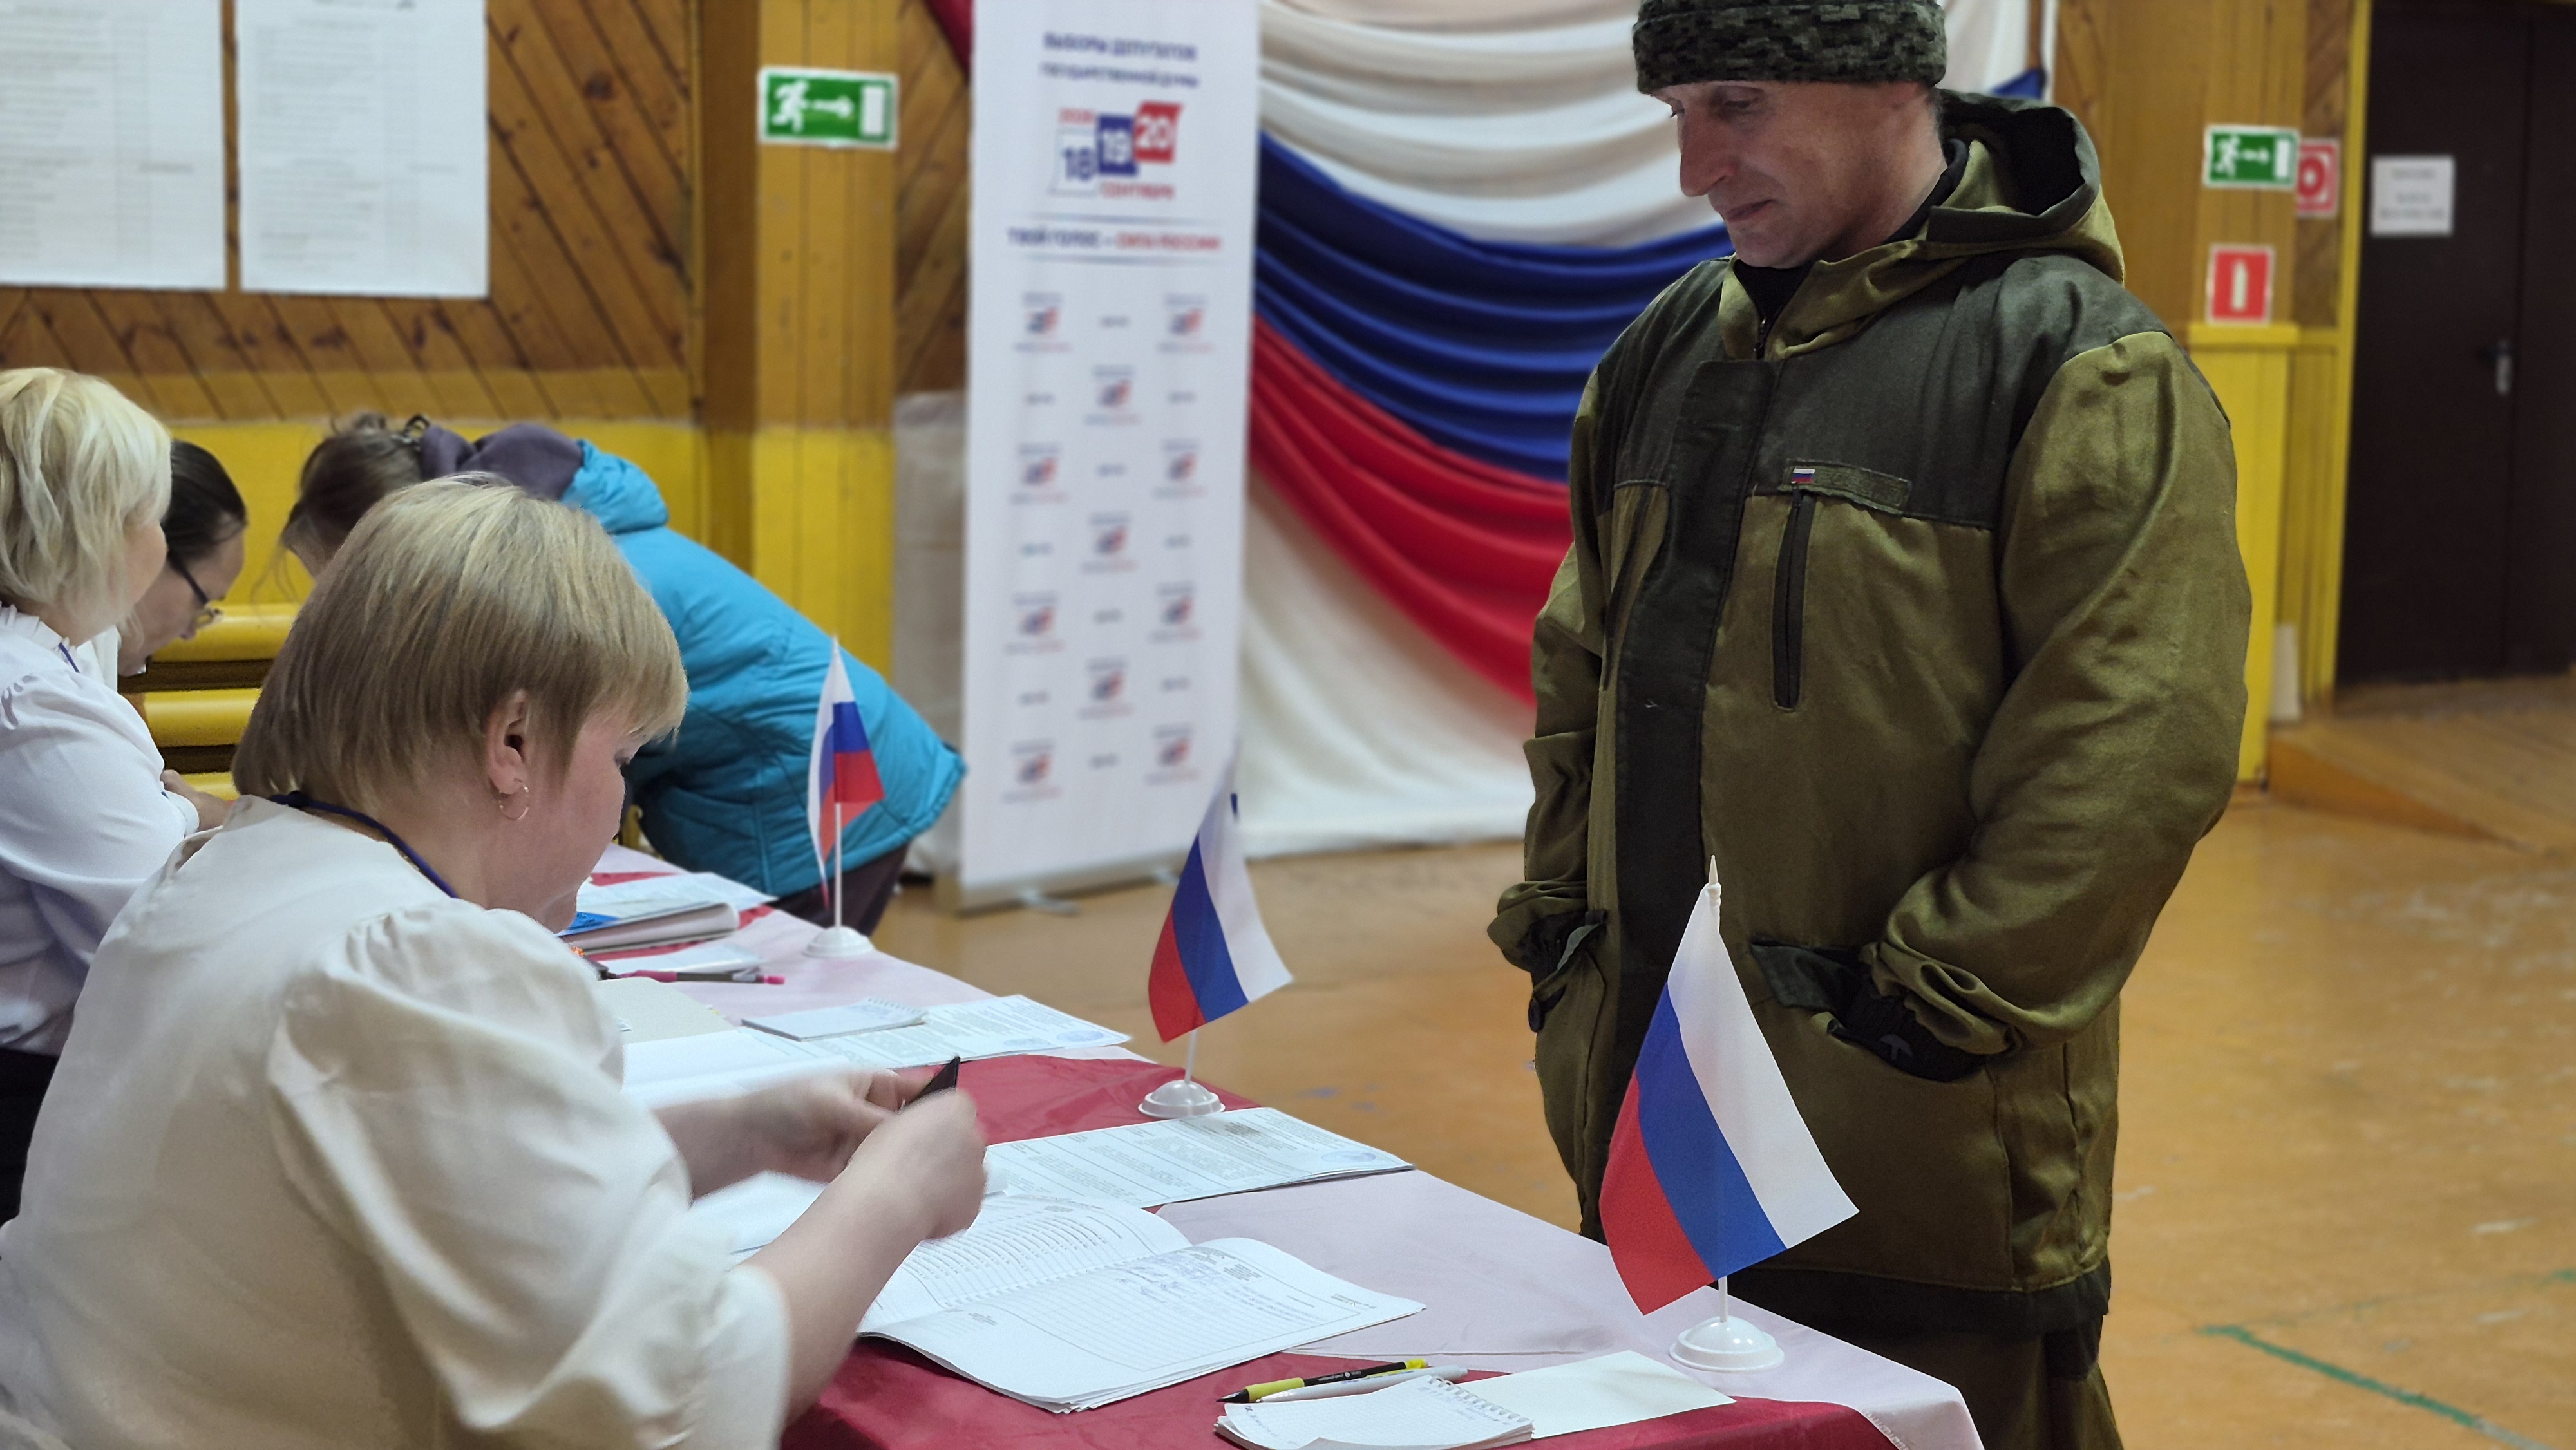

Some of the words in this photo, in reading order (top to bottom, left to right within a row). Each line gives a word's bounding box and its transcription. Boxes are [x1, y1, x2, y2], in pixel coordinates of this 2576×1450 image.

[1101, 130, 1130, 164] 19
[1137, 115, 1173, 149] 20
[1063, 147, 1094, 181] 18
